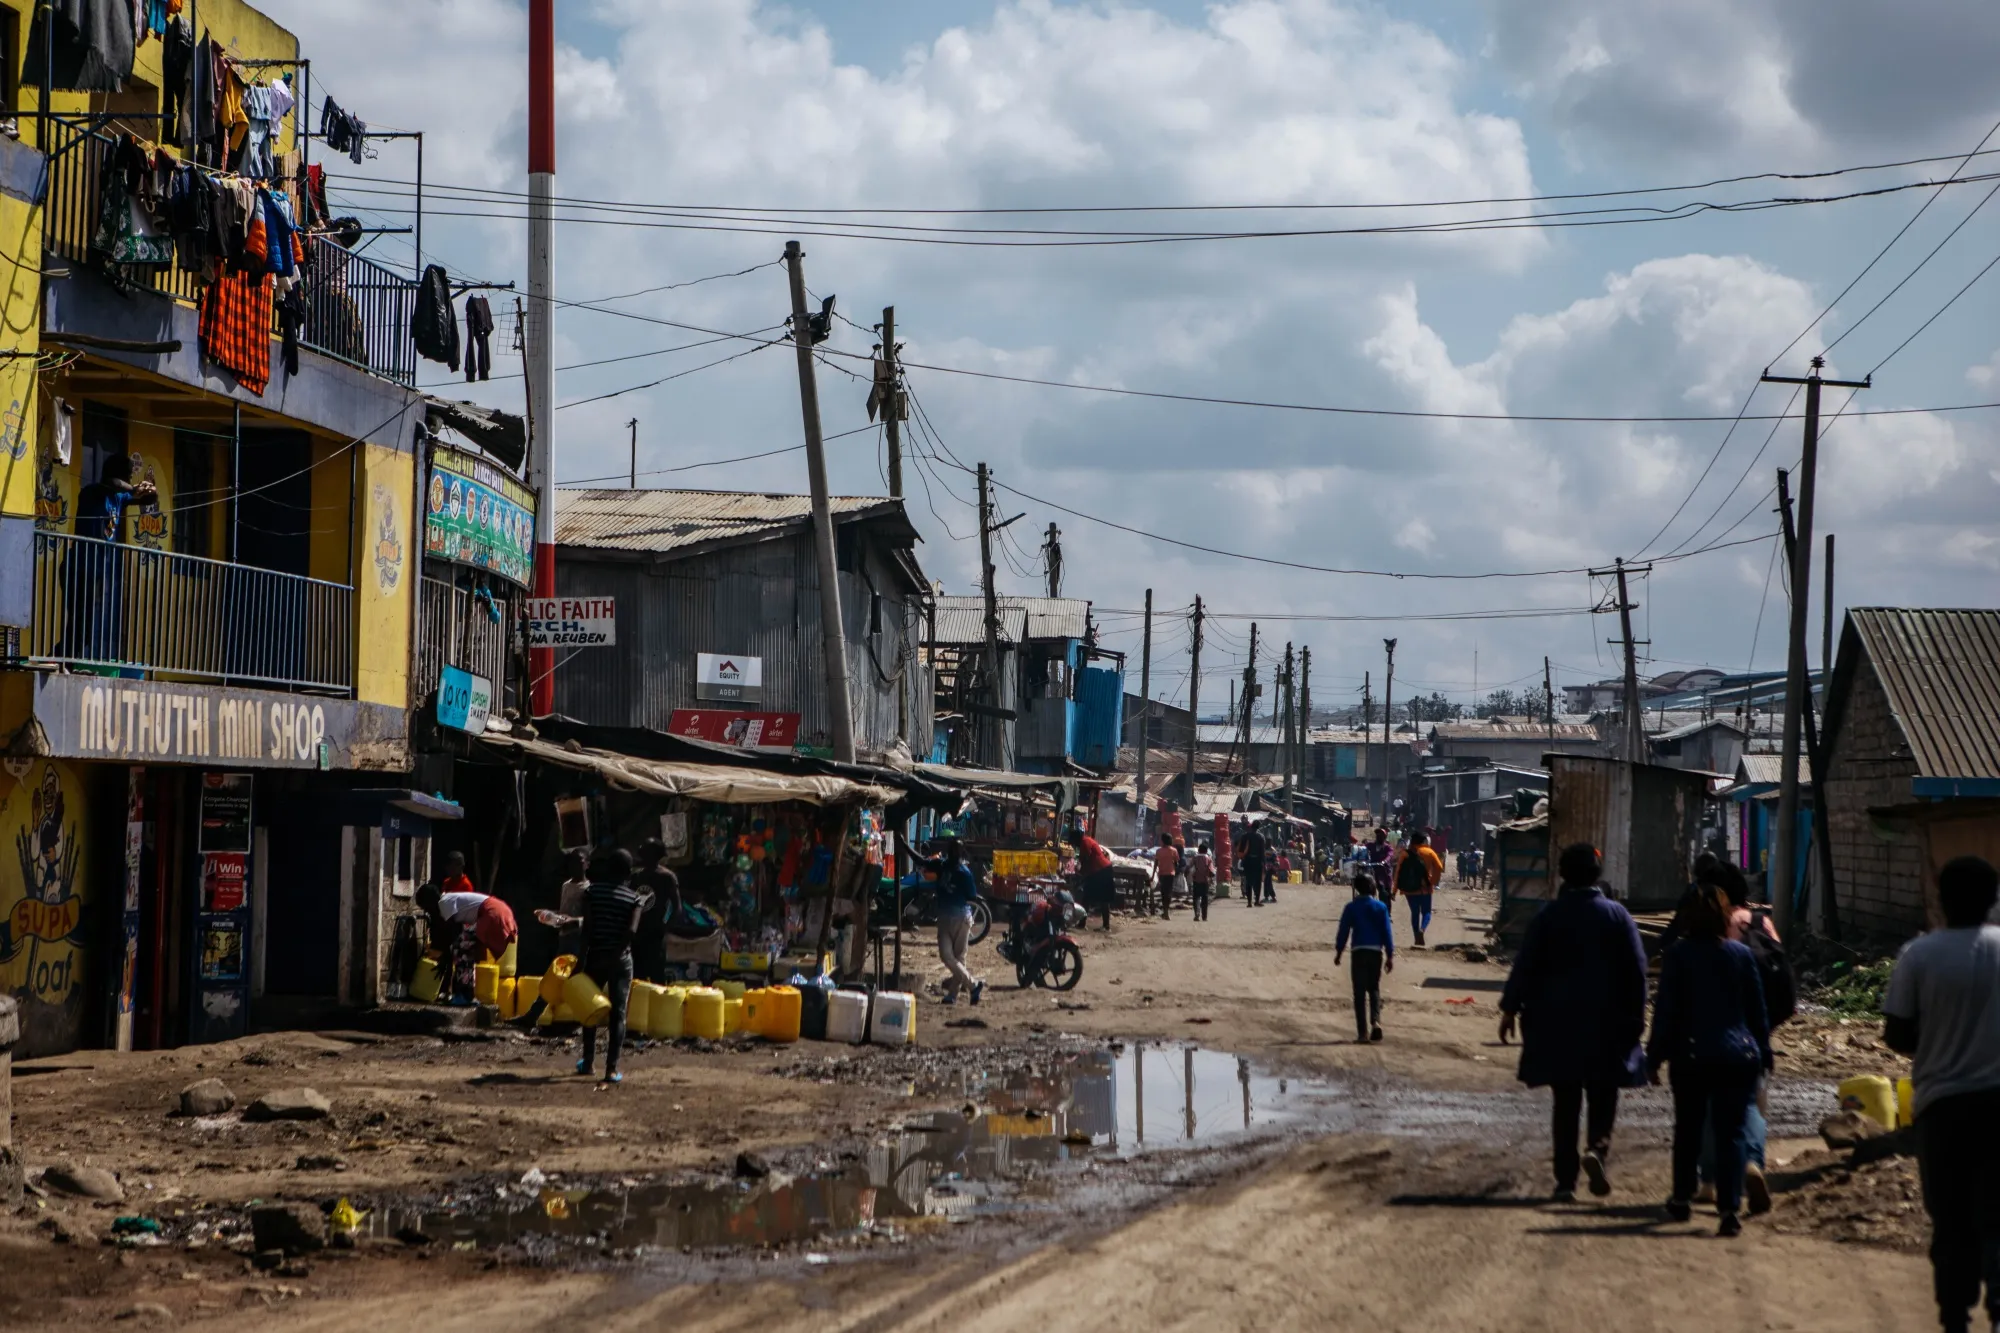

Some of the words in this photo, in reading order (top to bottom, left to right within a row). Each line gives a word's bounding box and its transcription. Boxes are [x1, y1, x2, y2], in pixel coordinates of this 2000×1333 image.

[141, 515, 160, 534] SUPA
[561, 599, 615, 619] FAITH
[529, 633, 547, 643] WA
[553, 633, 606, 643] REUBEN
[719, 672, 740, 680] EQUITY
[719, 689, 740, 697] AGENT
[470, 707, 487, 722] SMART
[80, 686, 209, 757] MUTHUTHI
[218, 697, 263, 759] MINI
[270, 702, 324, 761] SHOP
[684, 727, 700, 735] airtel
[768, 728, 784, 737] airtel
[219, 863, 242, 874] Win
[18, 901, 72, 939] SUPA
